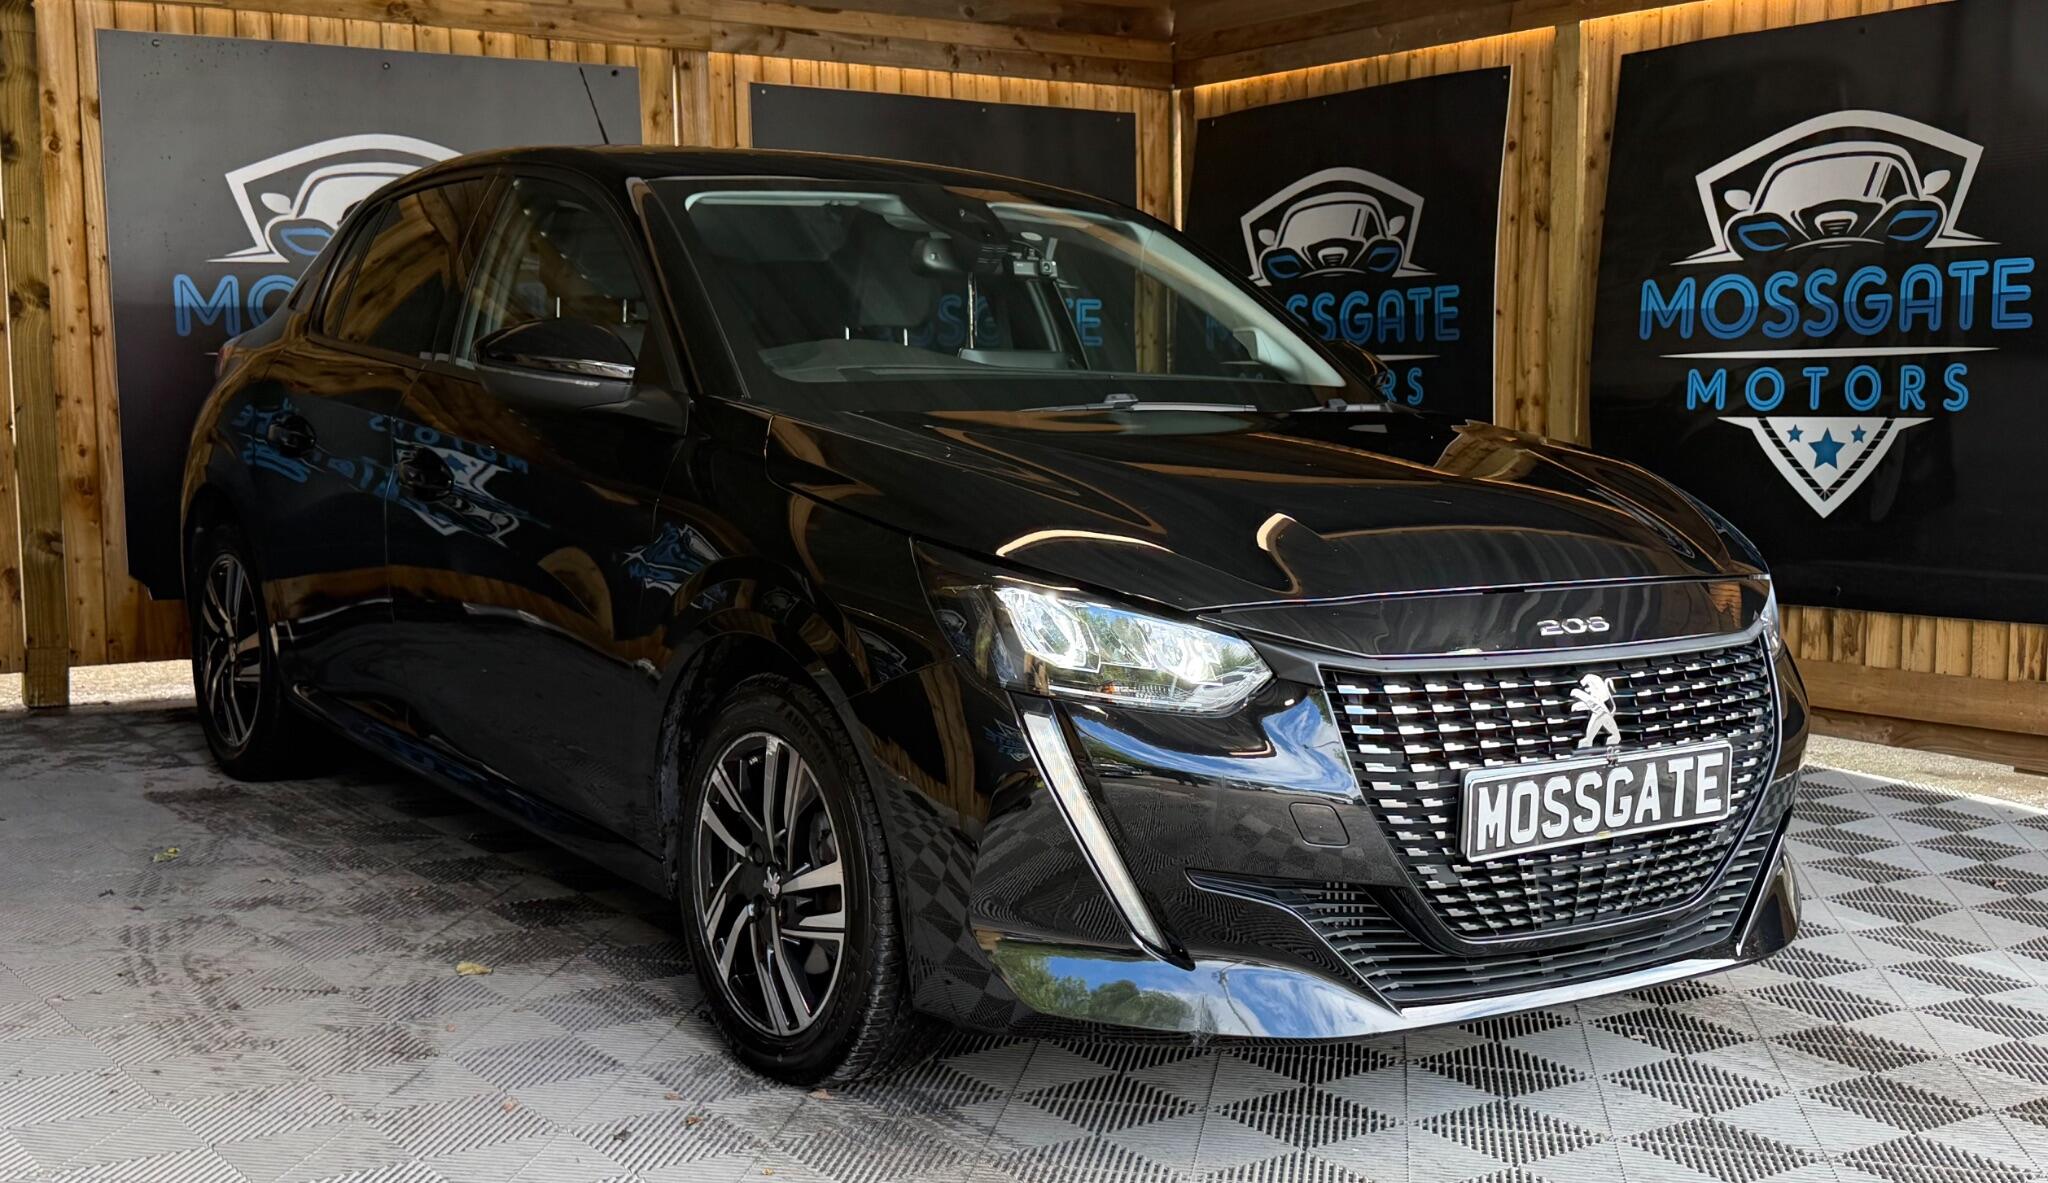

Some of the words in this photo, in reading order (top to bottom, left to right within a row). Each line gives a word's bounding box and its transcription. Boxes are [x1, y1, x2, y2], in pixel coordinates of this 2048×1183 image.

[1639, 256, 2036, 341] MOSSGATE
[1686, 362, 1970, 412] MOTORS
[1476, 751, 1725, 852] MOSSGATE
